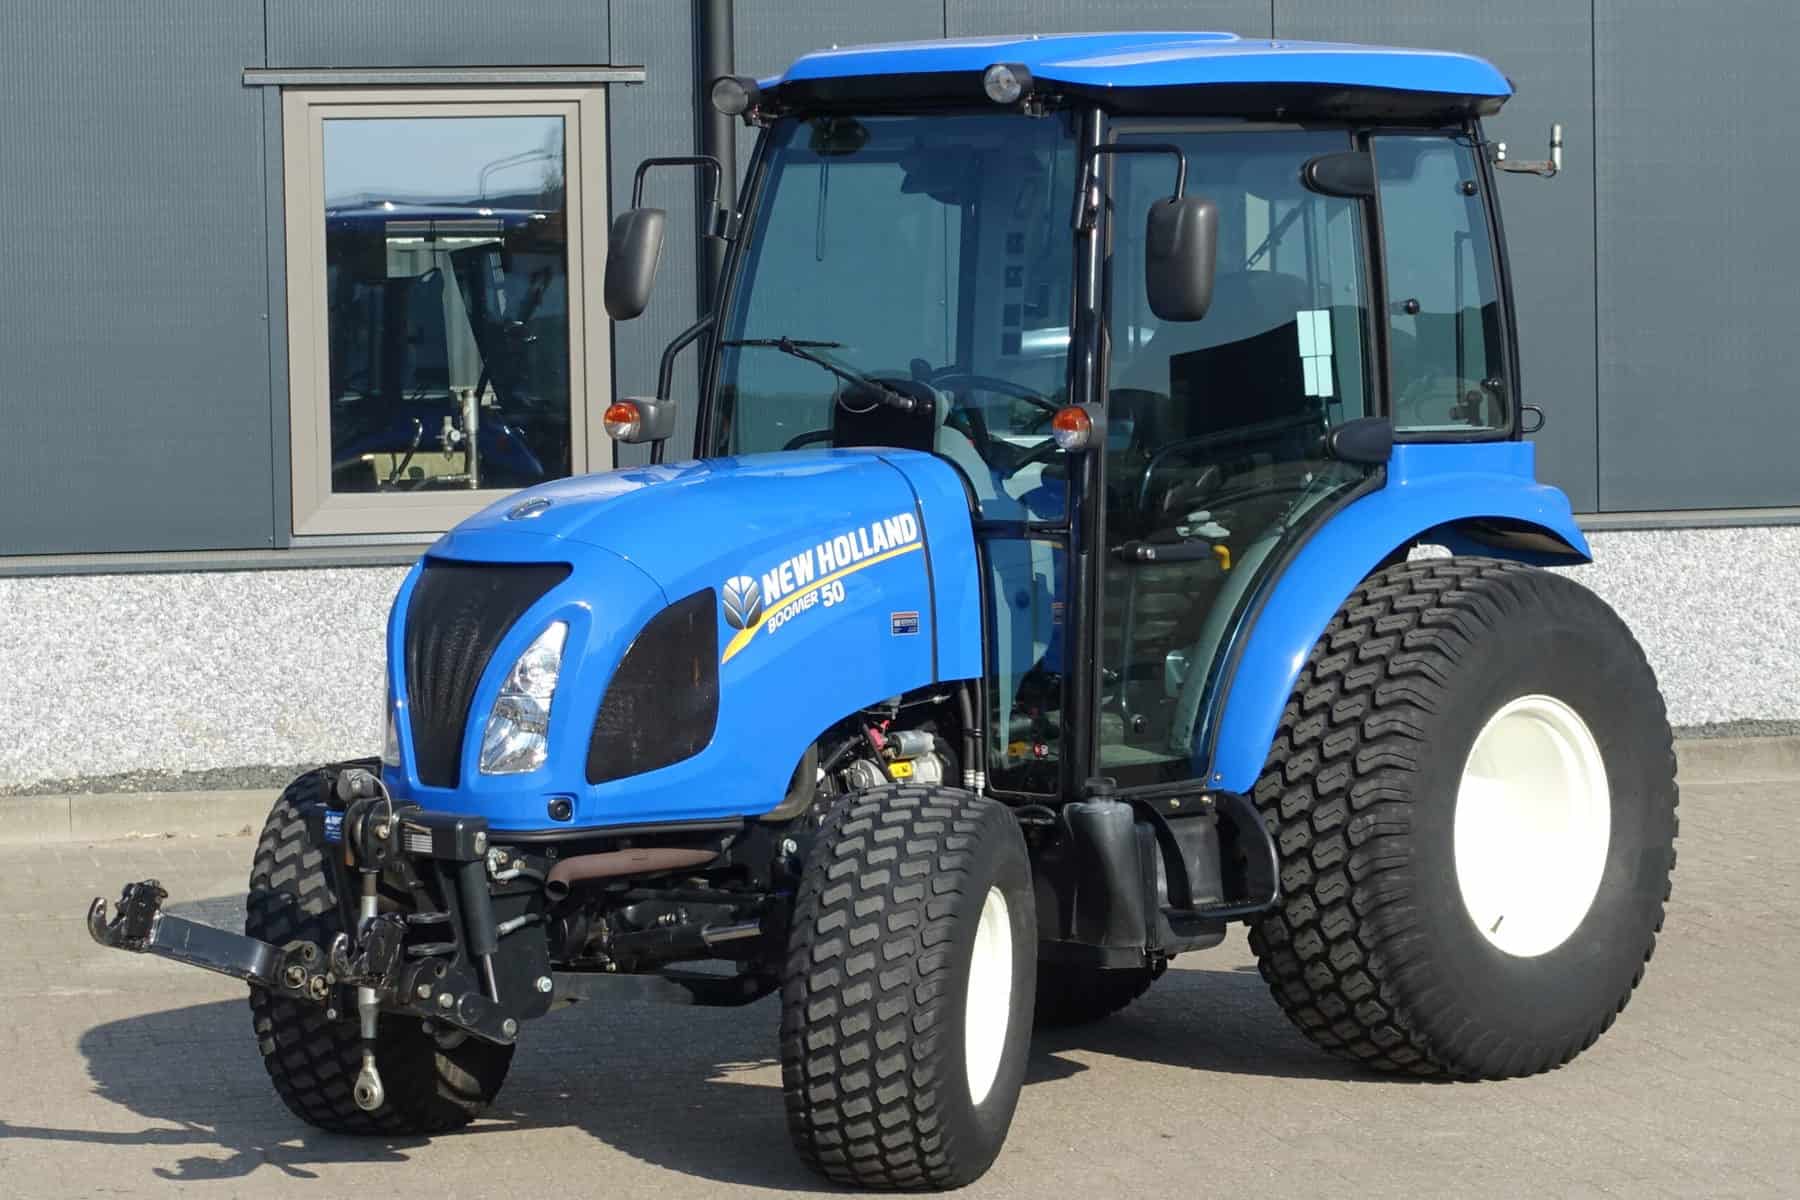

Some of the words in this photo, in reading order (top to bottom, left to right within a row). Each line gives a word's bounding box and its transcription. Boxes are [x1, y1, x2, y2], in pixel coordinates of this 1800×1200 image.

[762, 550, 814, 605] NEW
[816, 512, 918, 576] HOLLAND
[767, 591, 819, 634] BOOMER
[821, 580, 845, 608] 50
